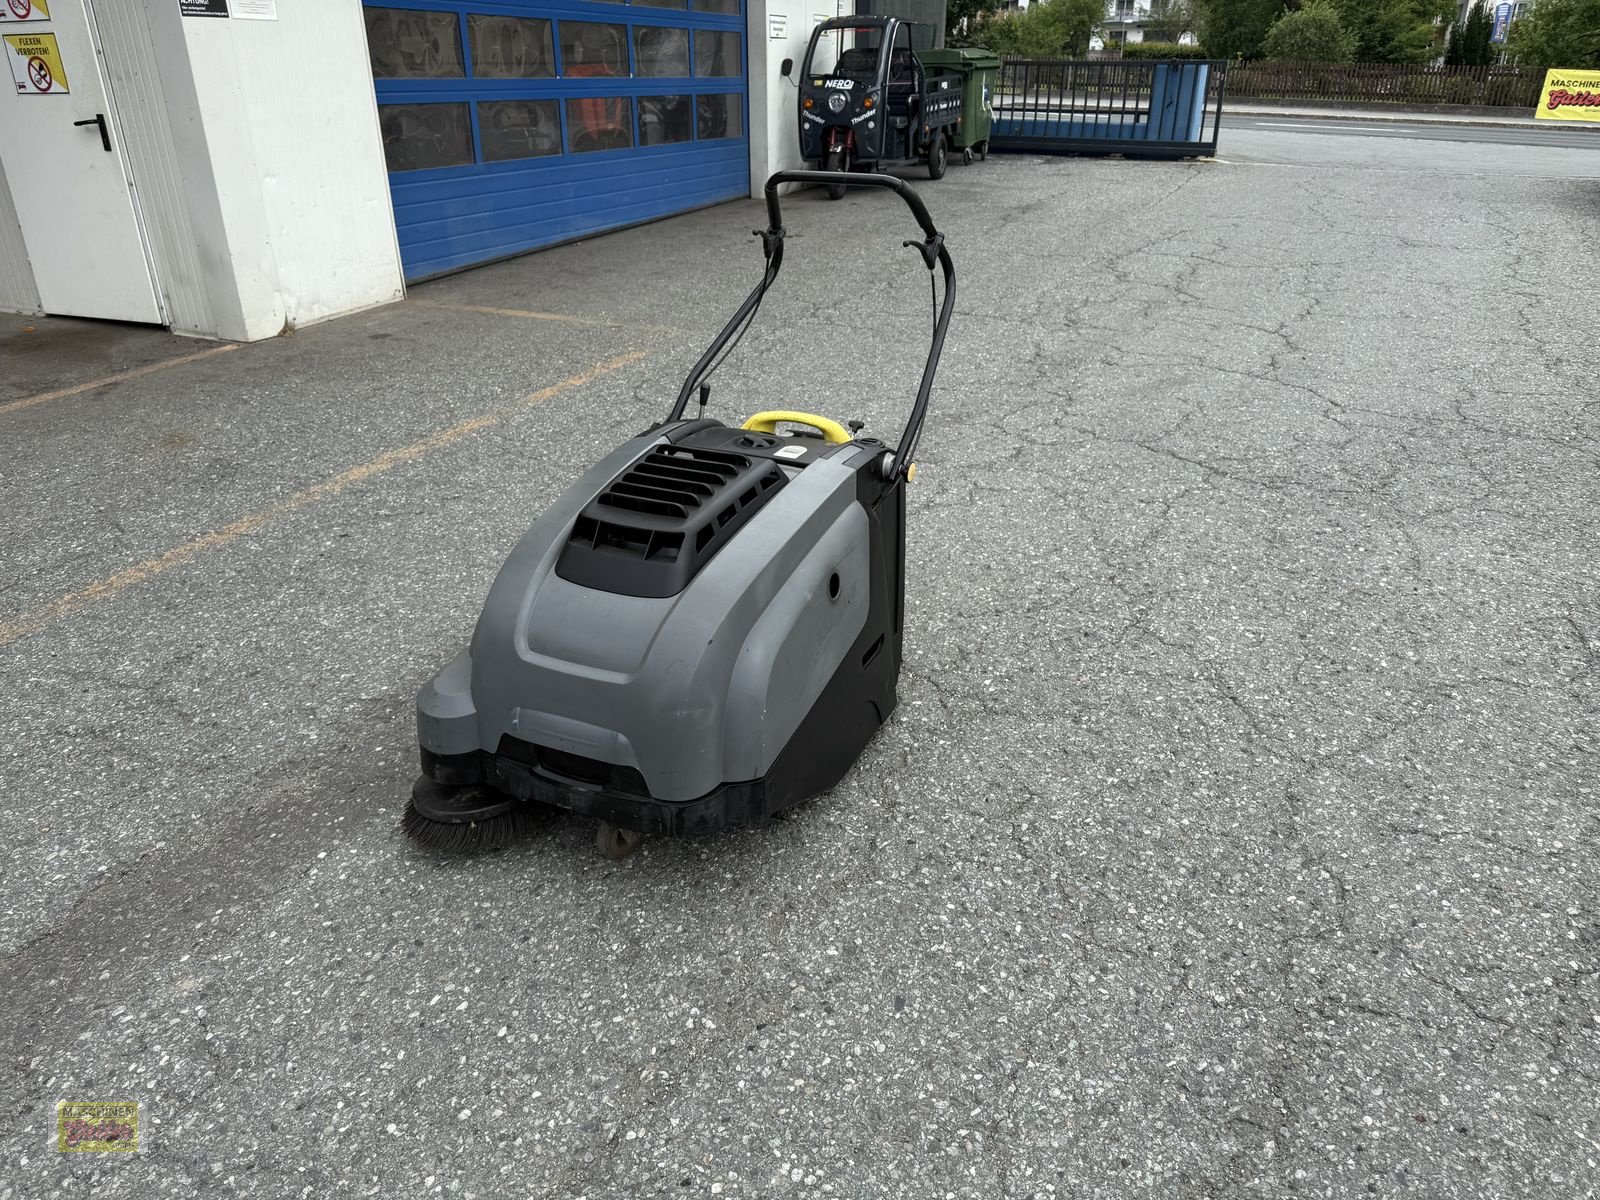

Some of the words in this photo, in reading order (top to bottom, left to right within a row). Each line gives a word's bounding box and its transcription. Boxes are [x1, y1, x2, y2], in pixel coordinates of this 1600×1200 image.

[18, 37, 42, 46] FLEXEN
[15, 47, 50, 56] VERBOTEN!
[803, 110, 826, 124] Thunder
[851, 109, 876, 125] Thunder
